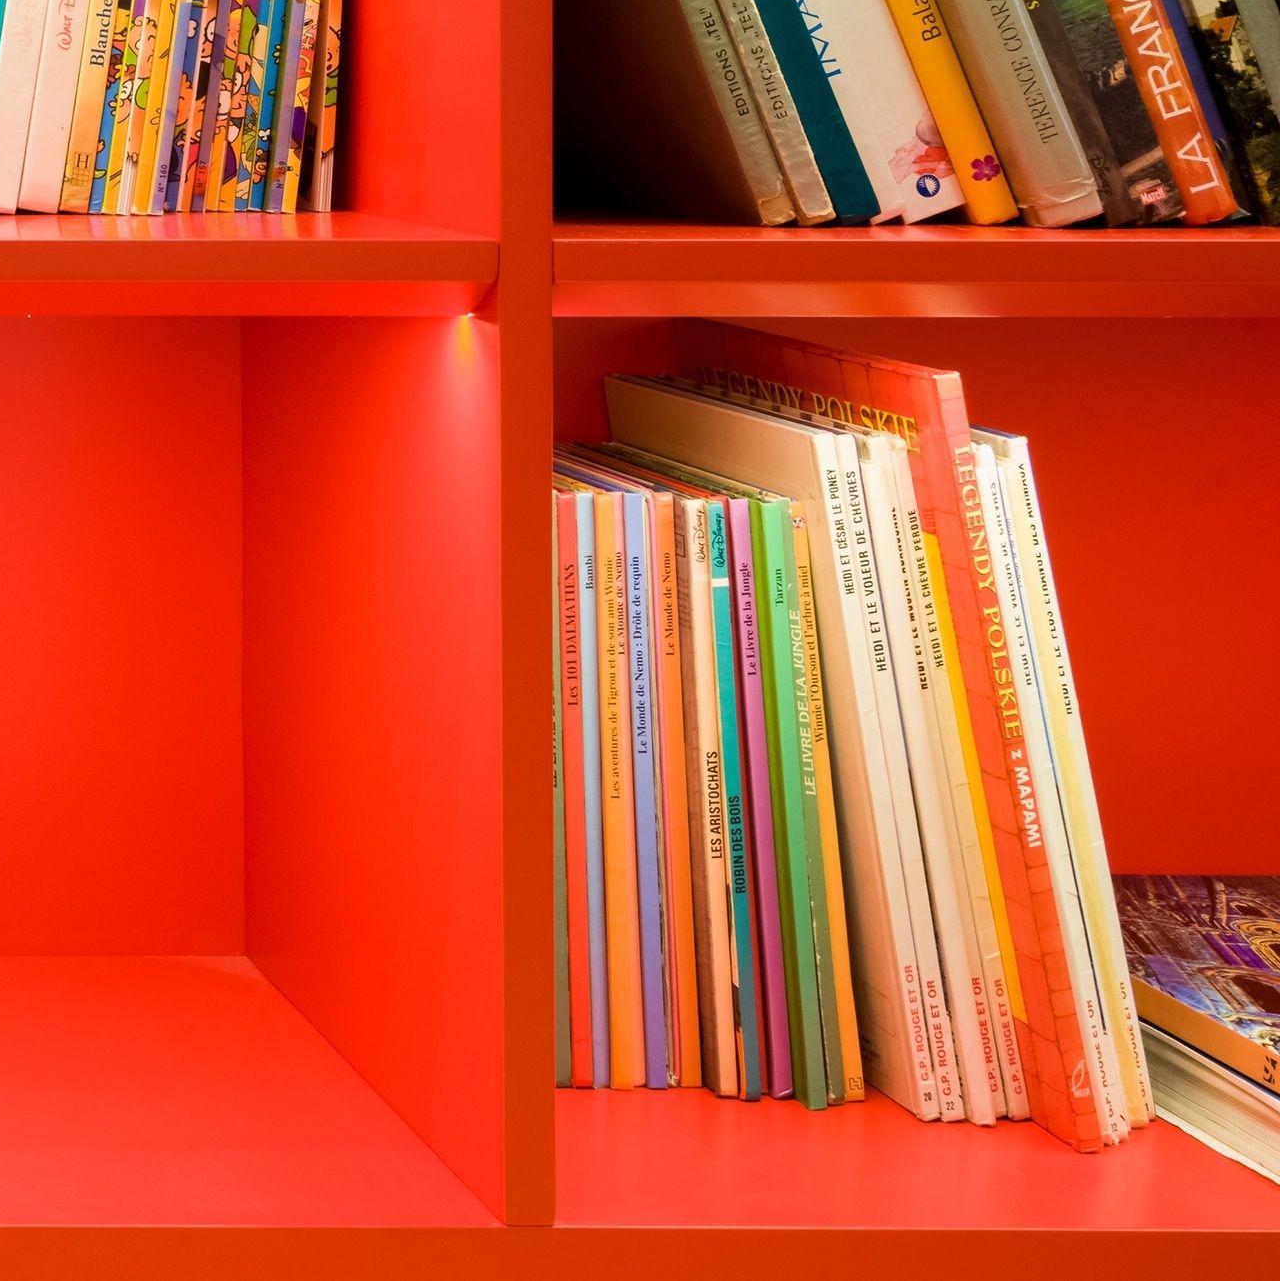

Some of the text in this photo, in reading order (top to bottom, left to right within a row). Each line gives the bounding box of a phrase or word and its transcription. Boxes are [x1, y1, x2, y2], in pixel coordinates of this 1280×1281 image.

[1172, 131, 1220, 195] LA
[825, 467, 856, 594] HEIDI ET CÉSAR LE PONEY
[844, 468, 888, 672] HEIDI ET LE VOLEUR DE CHÈVRES
[951, 444, 1023, 740] LEGENDY POLSKIE
[706, 750, 723, 858] LES ARISTOCHATS
[728, 794, 747, 893] ROBIN DES BOIS
[1009, 748, 1043, 848] z MAPAMI
